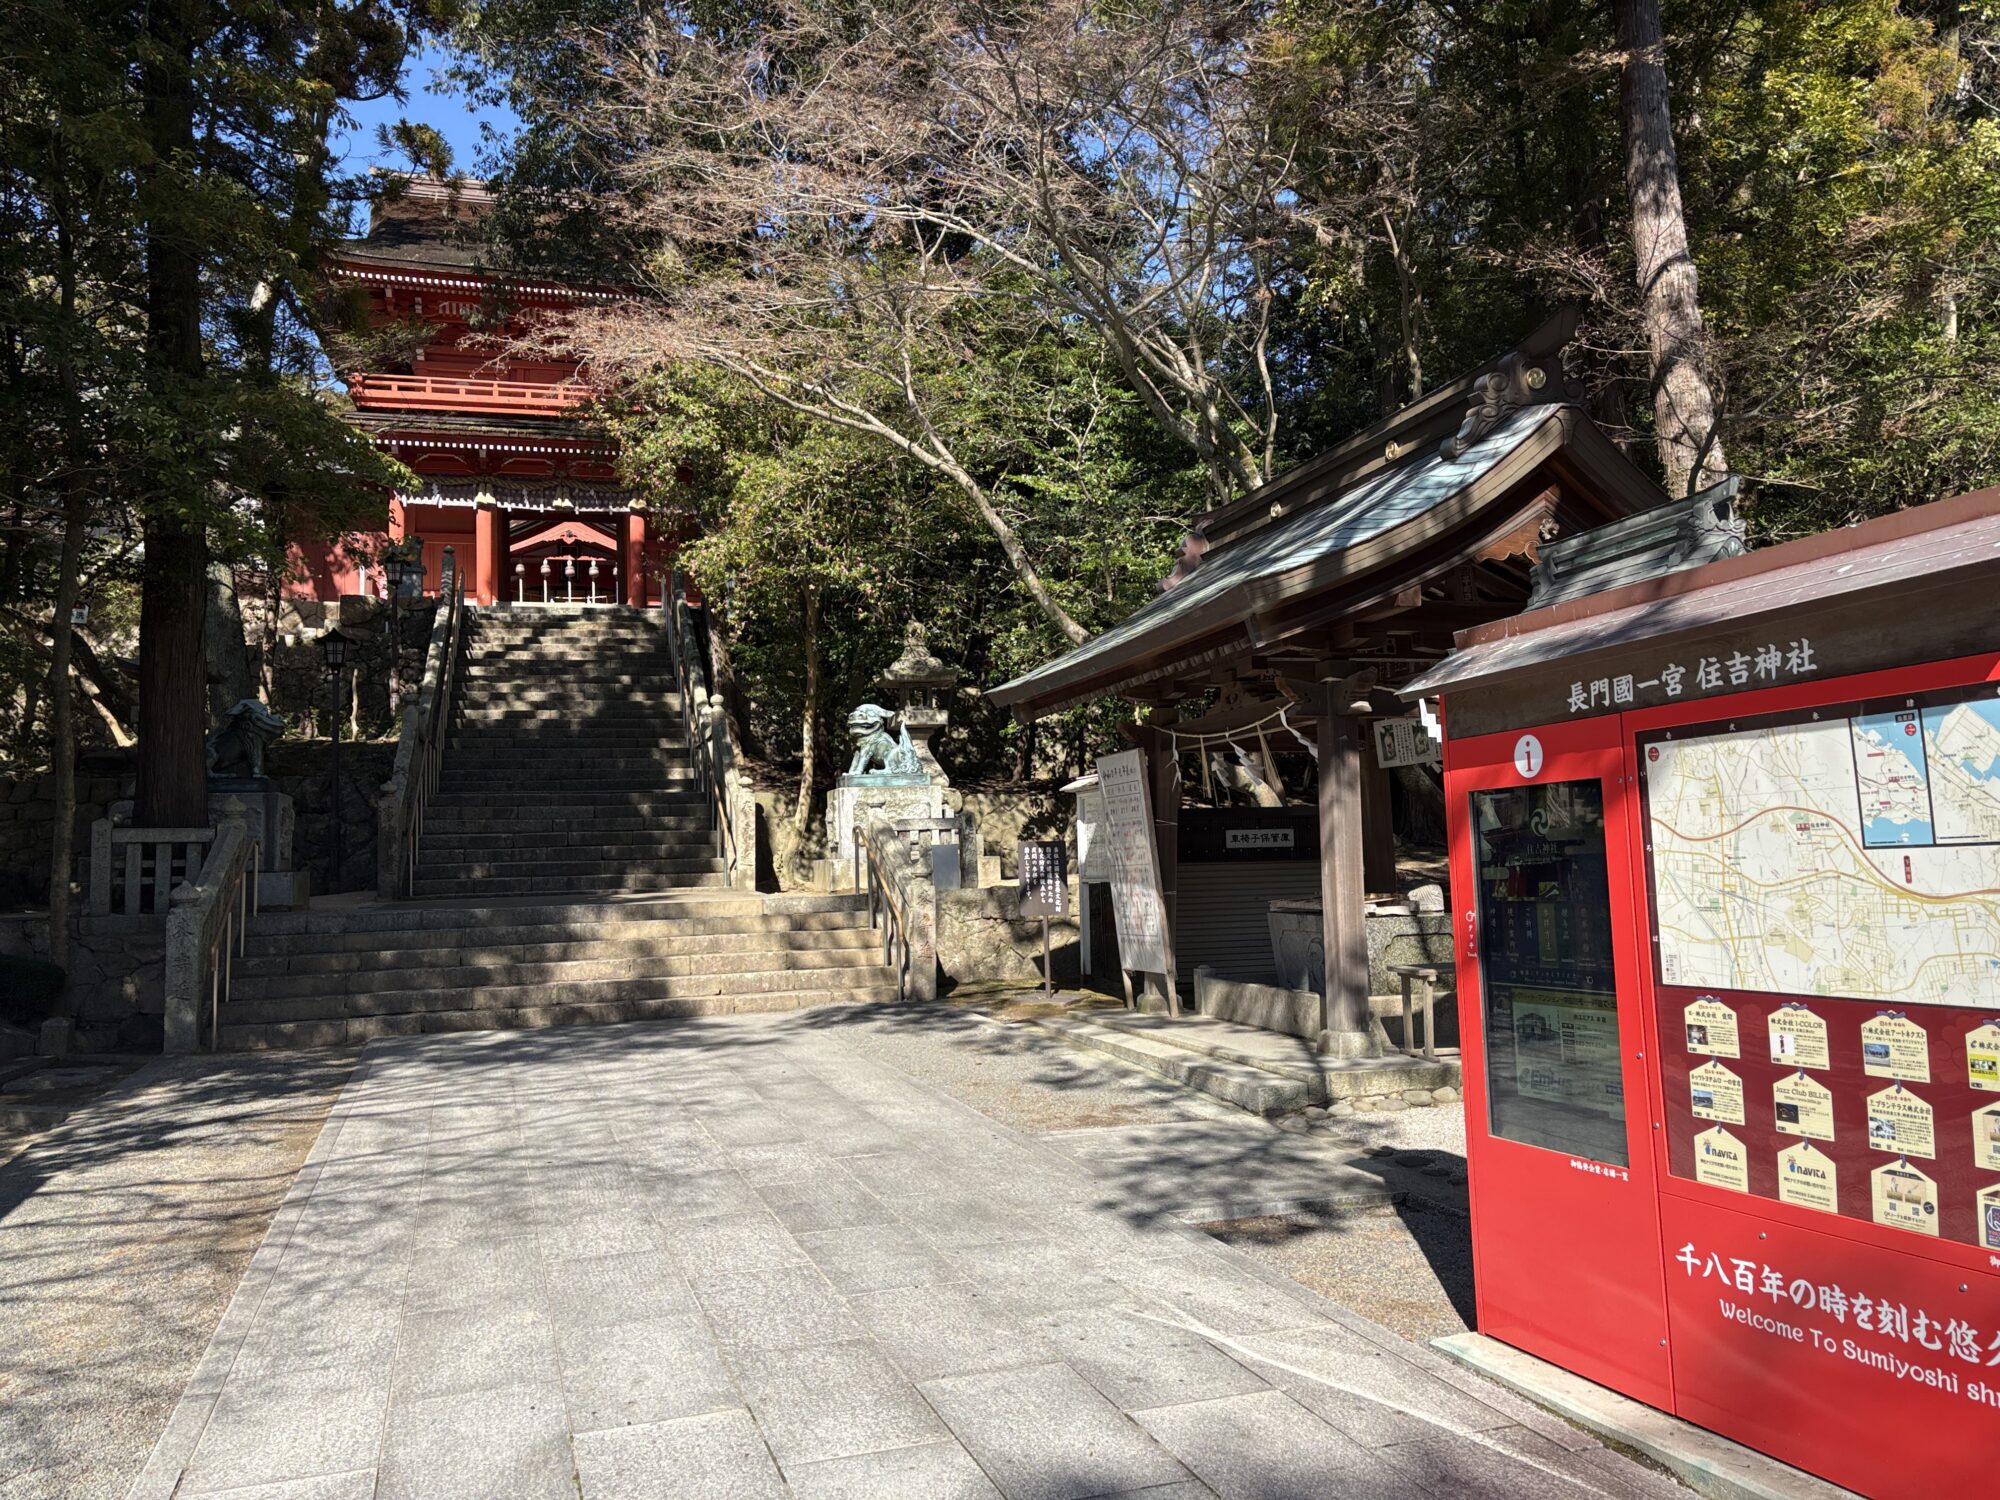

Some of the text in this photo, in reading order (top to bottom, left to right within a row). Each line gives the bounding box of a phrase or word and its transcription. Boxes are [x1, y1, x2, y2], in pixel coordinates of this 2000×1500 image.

[1567, 638, 1818, 713] 長門國一宮 住吉神社
[1231, 832, 1291, 844] 車椅子保管庫
[1024, 846, 1033, 900] 禁止しております。
[1695, 1011, 1717, 1019] 株式会社
[1770, 1018, 1794, 1027] 株式会社
[1868, 1027, 1926, 1040] 株式会社アートネクスト
[1775, 1086, 1830, 1101] Jazz Club BILLIE
[1719, 1298, 1804, 1343] Welcome
[1809, 1327, 1837, 1353] To
[1842, 1339, 1959, 1395] Sumiyoshi
